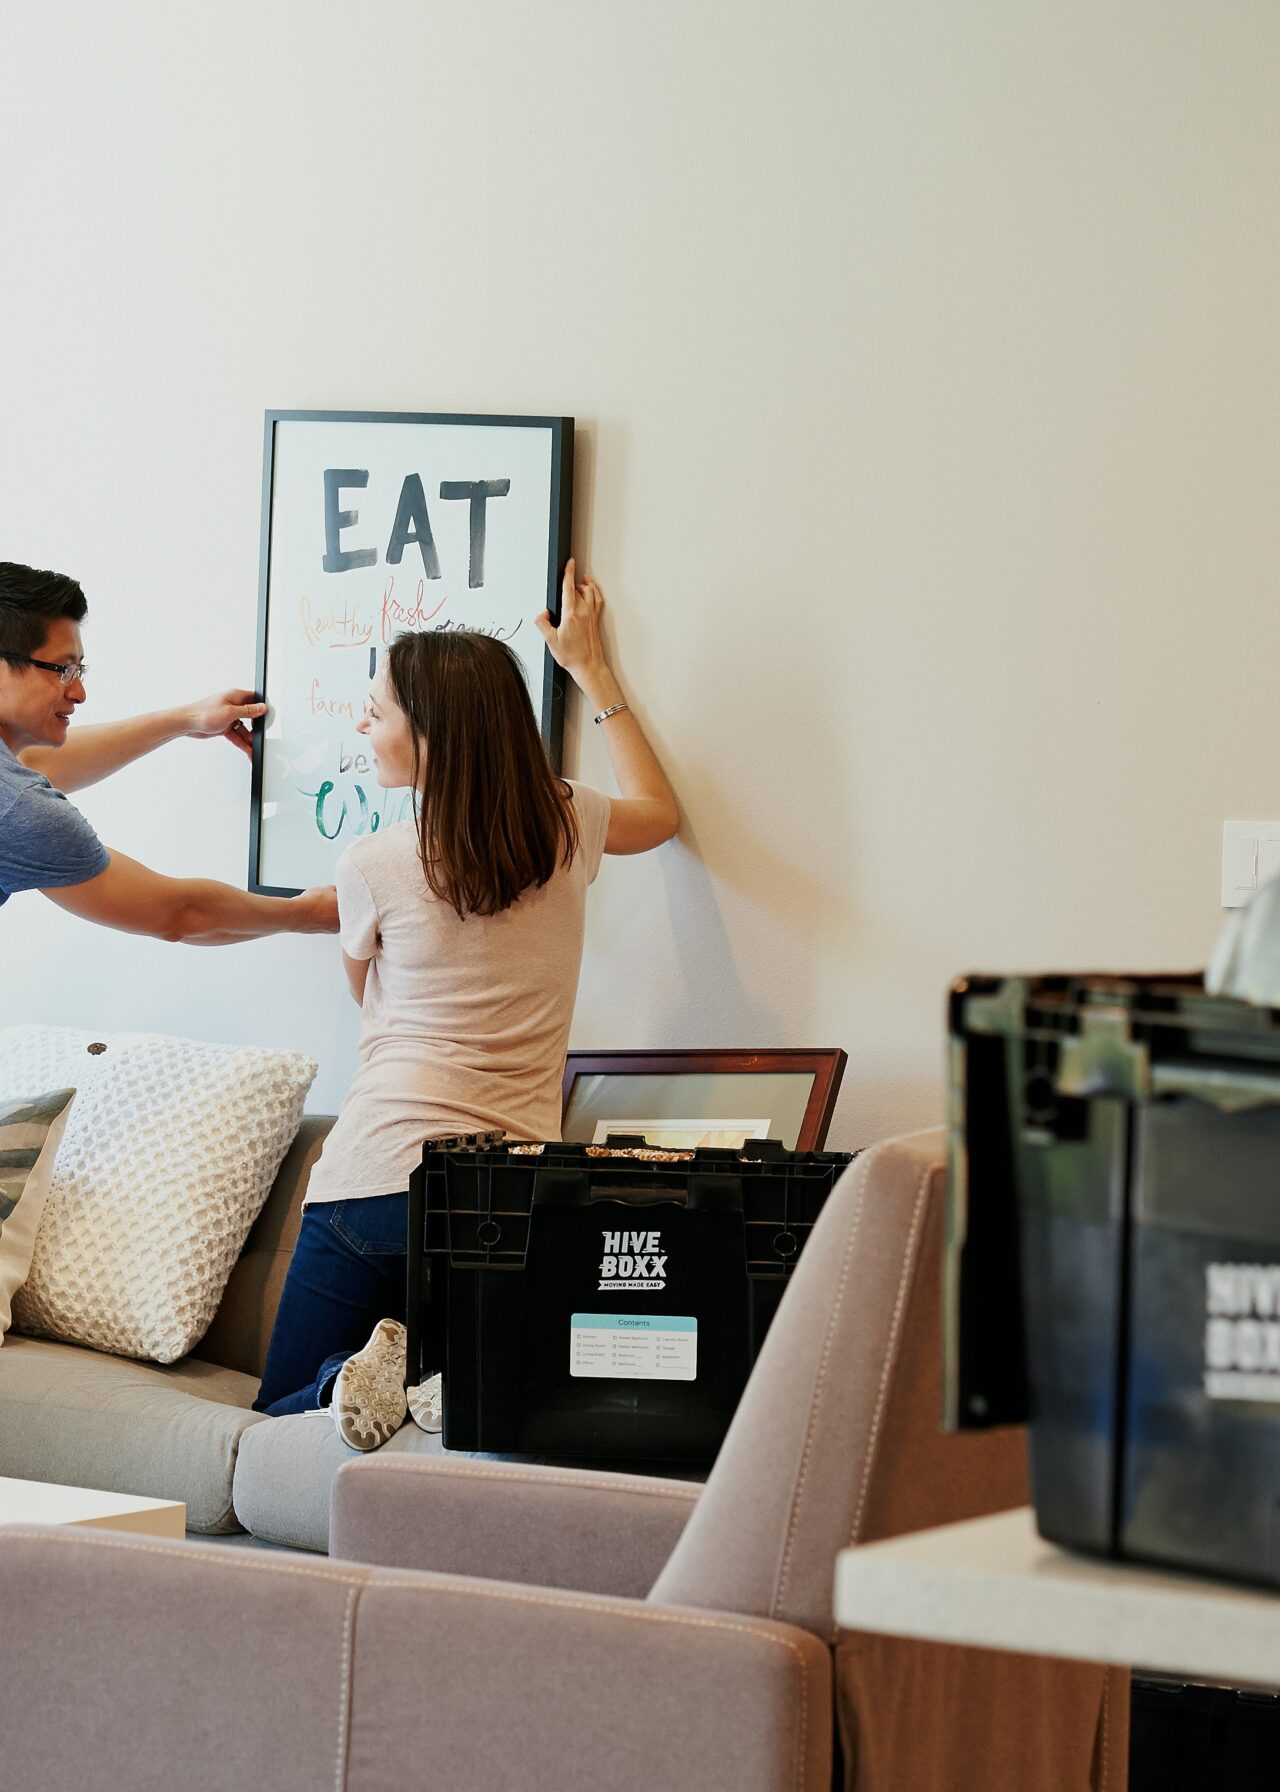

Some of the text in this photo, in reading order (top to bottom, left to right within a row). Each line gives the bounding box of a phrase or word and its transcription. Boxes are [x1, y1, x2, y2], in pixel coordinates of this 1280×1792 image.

[322, 469, 511, 588] EAT
[380, 576, 448, 645] fresh
[307, 678, 354, 720] farm
[339, 740, 371, 774] be
[601, 1231, 661, 1253] HIVE
[598, 1255, 669, 1277] BOXX
[618, 1319, 651, 1327] Contents
